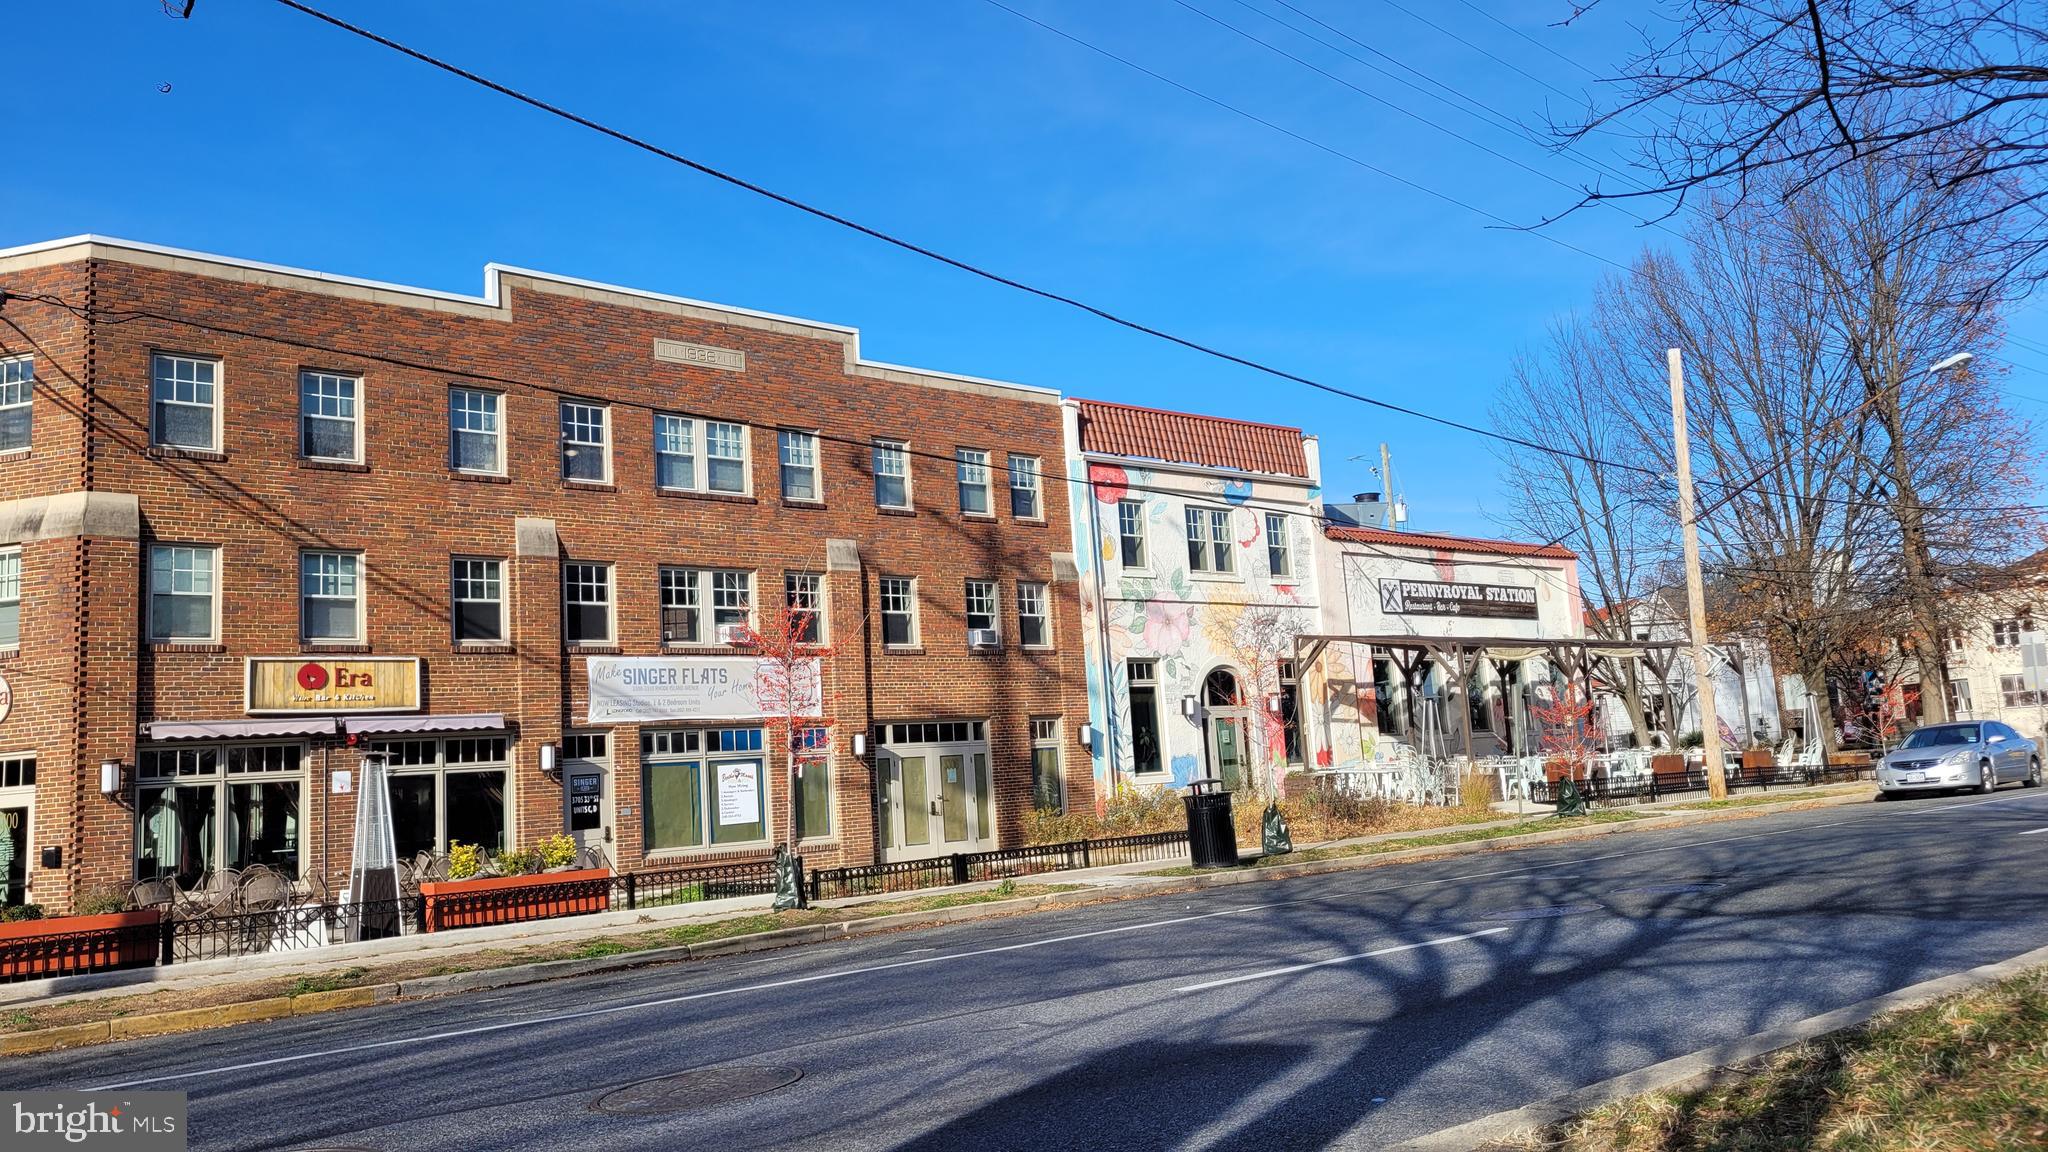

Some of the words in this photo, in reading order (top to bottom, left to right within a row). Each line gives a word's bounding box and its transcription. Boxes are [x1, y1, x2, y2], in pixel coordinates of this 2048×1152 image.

[1400, 582, 1483, 600] PENNYROYAL
[1485, 586, 1535, 603] STATION
[335, 667, 373, 688] Era
[595, 663, 621, 684] Make
[622, 668, 677, 685] SINGER
[682, 667, 728, 685] FLATS
[707, 685, 727, 700] Your
[573, 777, 598, 787] SINGER
